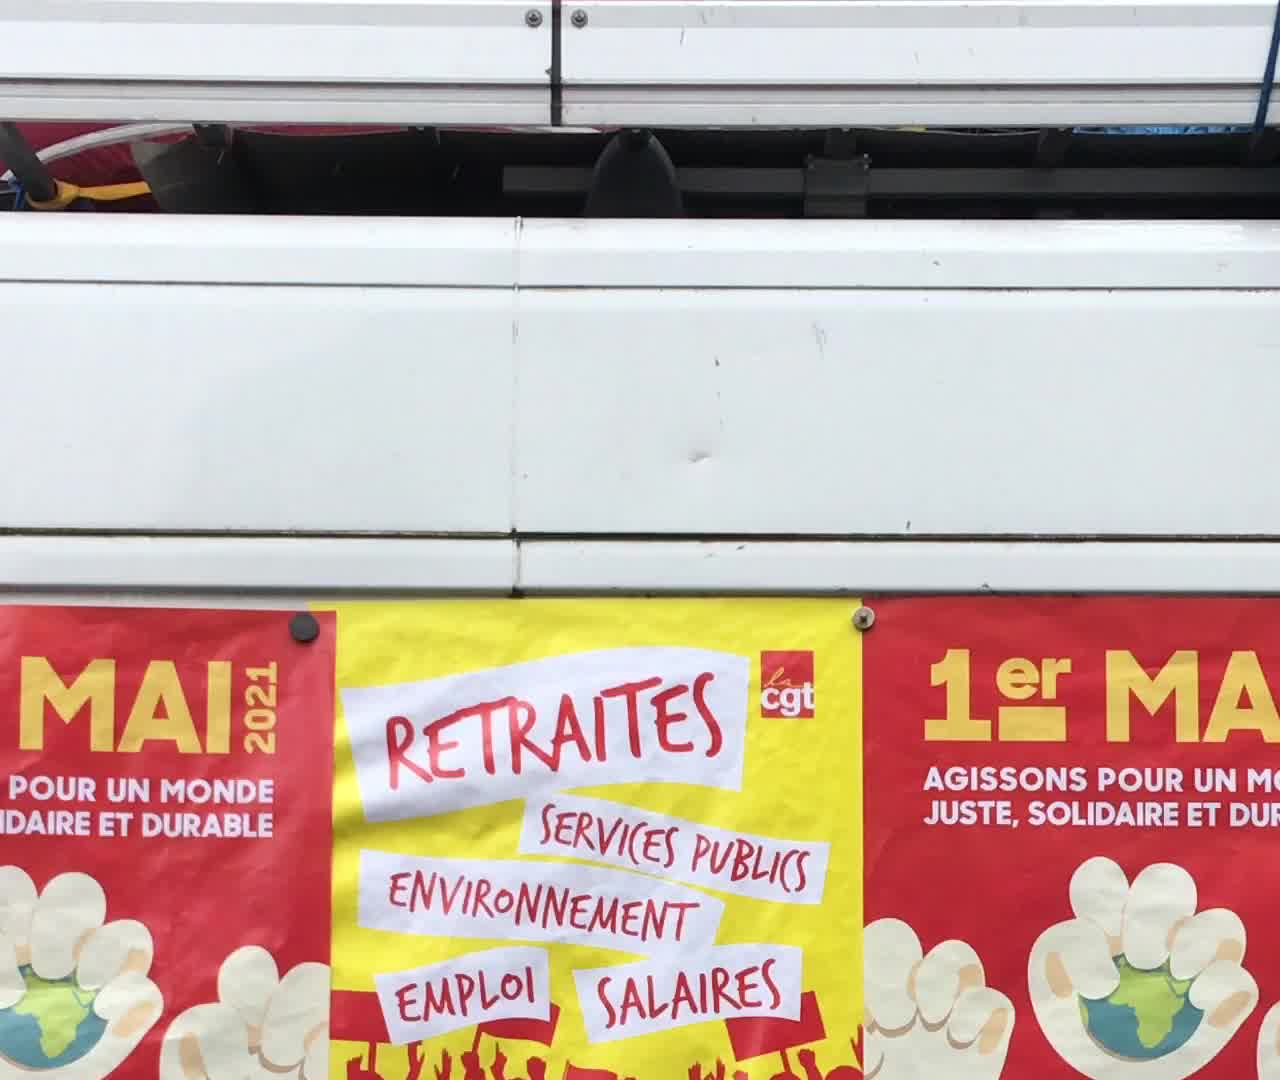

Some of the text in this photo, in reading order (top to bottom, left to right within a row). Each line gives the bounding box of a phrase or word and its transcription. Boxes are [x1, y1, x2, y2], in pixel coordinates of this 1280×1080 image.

[20, 655, 232, 754] MAI
[243, 660, 278, 754] 2021
[761, 682, 816, 717] cgt
[924, 649, 1072, 741] 1er
[386, 672, 723, 790] RETRAITES
[9, 775, 96, 801] POUR
[107, 777, 149, 802] UN
[160, 778, 275, 804] MONDE
[923, 766, 1087, 792] AGISSONS
[1098, 767, 1184, 792] POUR
[1194, 768, 1237, 793] UN
[923, 801, 1019, 829] JUSTE,
[1028, 801, 1179, 827] SOLIDAIRE
[1187, 802, 1221, 827] ET
[99, 810, 133, 837] ET
[142, 812, 273, 839] DURABLE
[540, 804, 810, 893] SERVICES PUBLICS
[388, 870, 700, 942] ENVIRONNEMENT
[395, 966, 535, 1022] EMPLOI
[598, 958, 781, 1029] SALAIRES
